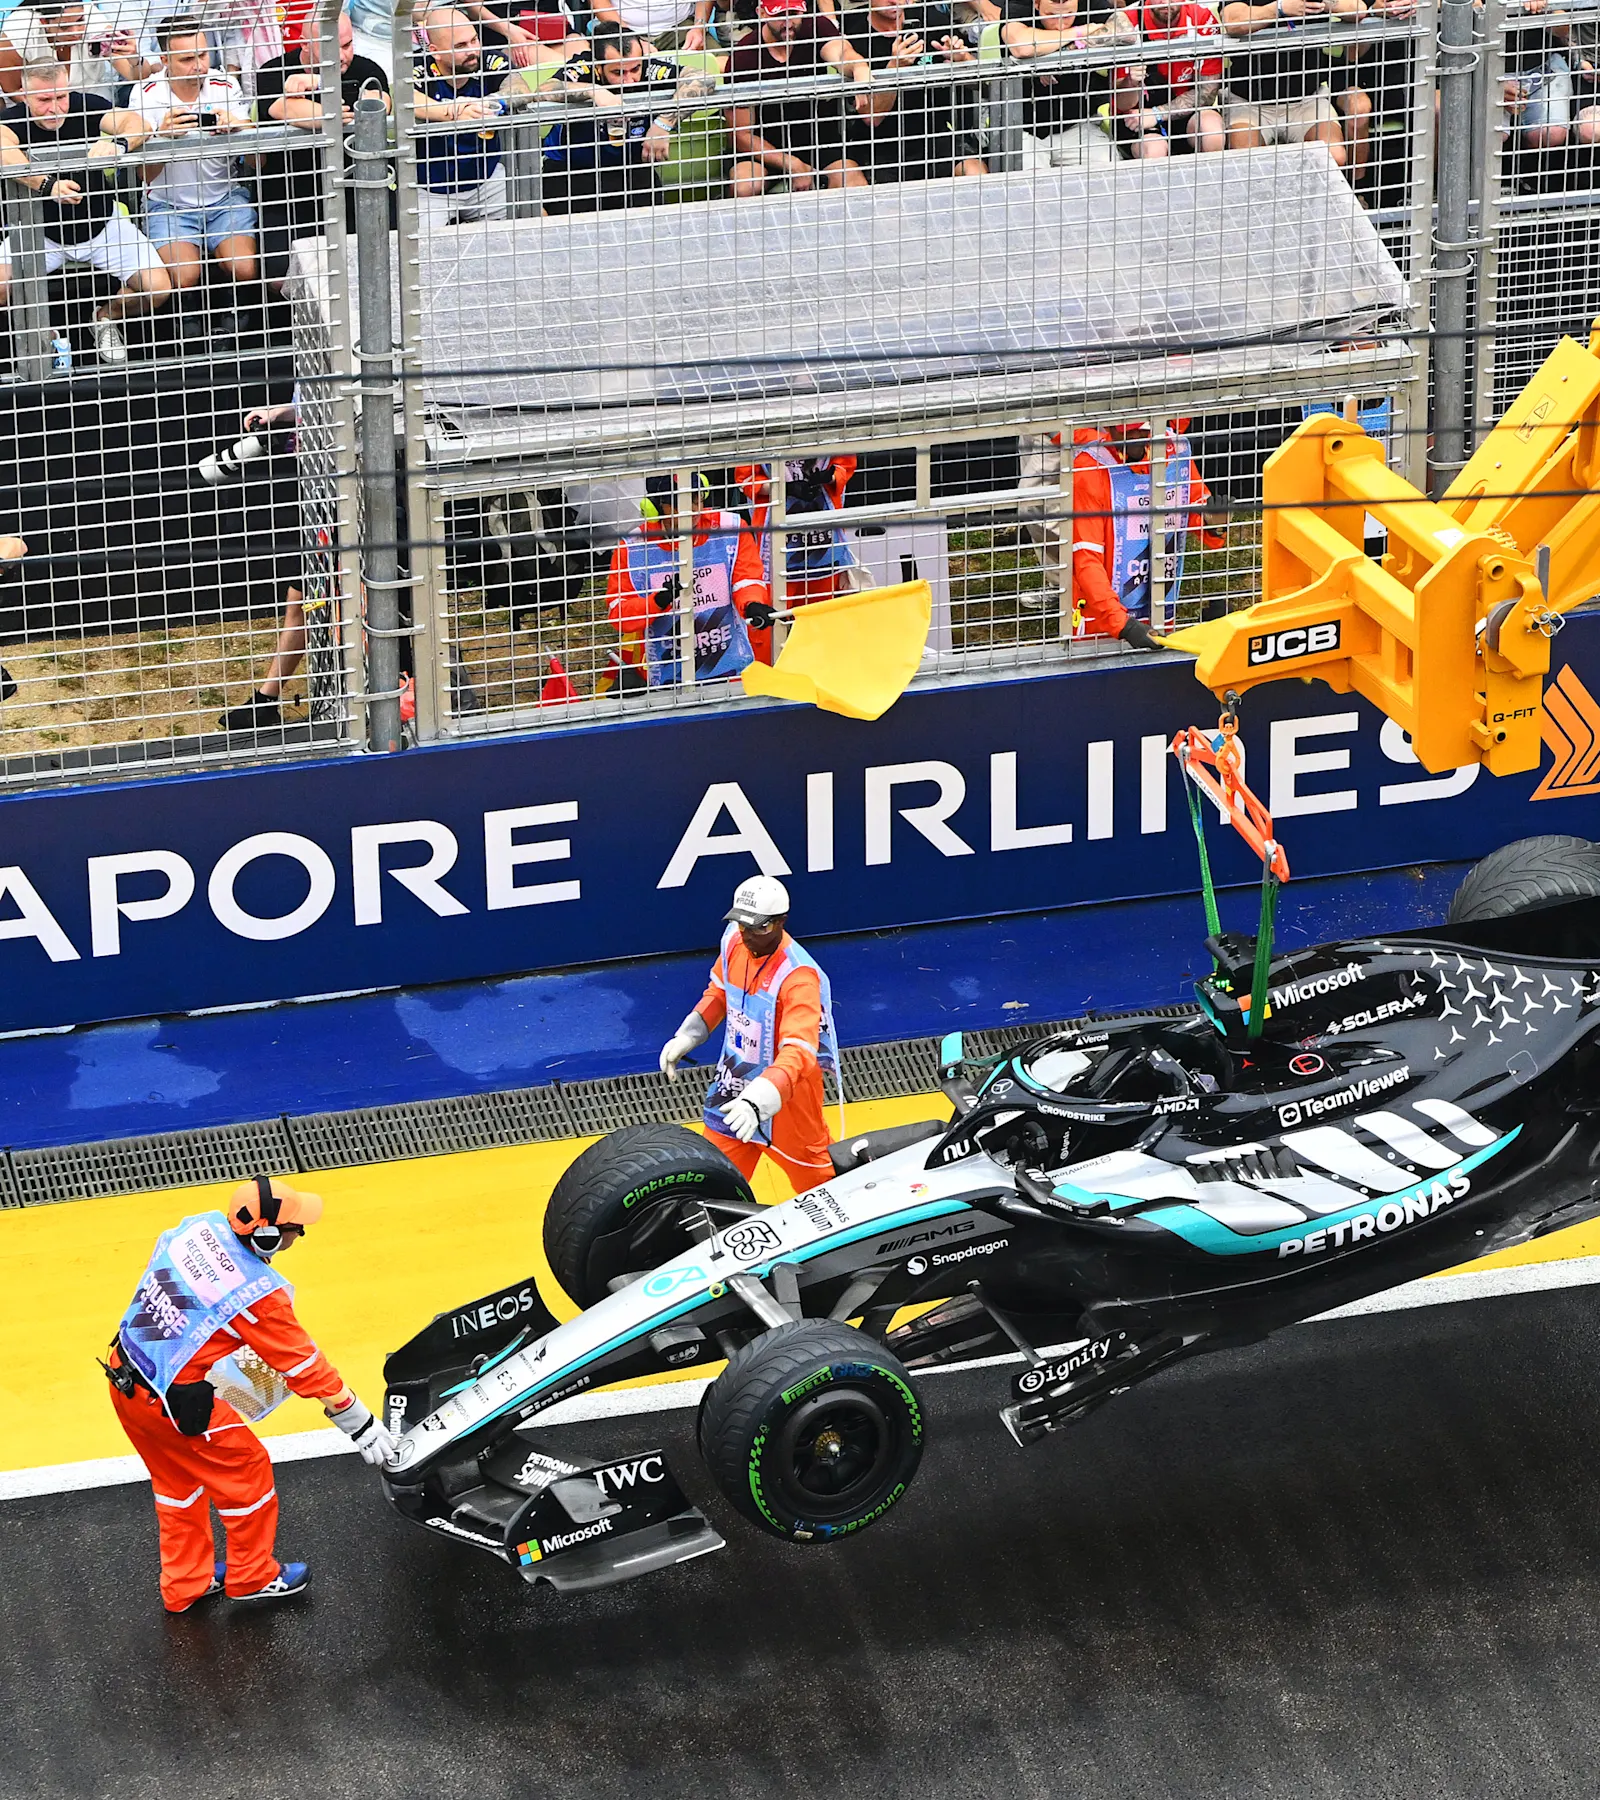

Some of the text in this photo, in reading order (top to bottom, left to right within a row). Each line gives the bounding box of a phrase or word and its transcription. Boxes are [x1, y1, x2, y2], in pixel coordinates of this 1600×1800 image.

[1250, 623, 1338, 664] JCB
[1493, 707, 1537, 724] Q-FIT
[656, 710, 1480, 890] AIRLINES
[1273, 961, 1367, 1011] Microsoft
[1340, 997, 1416, 1032] SOLERA
[1083, 1032, 1110, 1045] Vercel
[1151, 1100, 1188, 1116] AMD
[1299, 1064, 1412, 1119] TeamViewer
[1042, 1104, 1106, 1122] CROWDSTRIKE
[622, 1171, 705, 1209] Cinturato
[816, 1187, 850, 1225] PETRONAS
[794, 1192, 833, 1232] Syntium
[1277, 1166, 1471, 1260] PETRONAS
[199, 1228, 235, 1273] 0926-SGP
[723, 1219, 782, 1262] 63
[909, 1220, 976, 1246] AMG
[932, 1236, 1009, 1266] Snapdragon
[181, 1254, 203, 1281] TEAM
[184, 1238, 221, 1284] RECOVERY
[141, 1270, 191, 1337] COURSE
[451, 1287, 534, 1339] INEOS
[780, 1365, 833, 1405] PIRELLI
[593, 1456, 666, 1494] IWC
[830, 1482, 905, 1536] Cinturato
[542, 1517, 613, 1554] Microsoft
